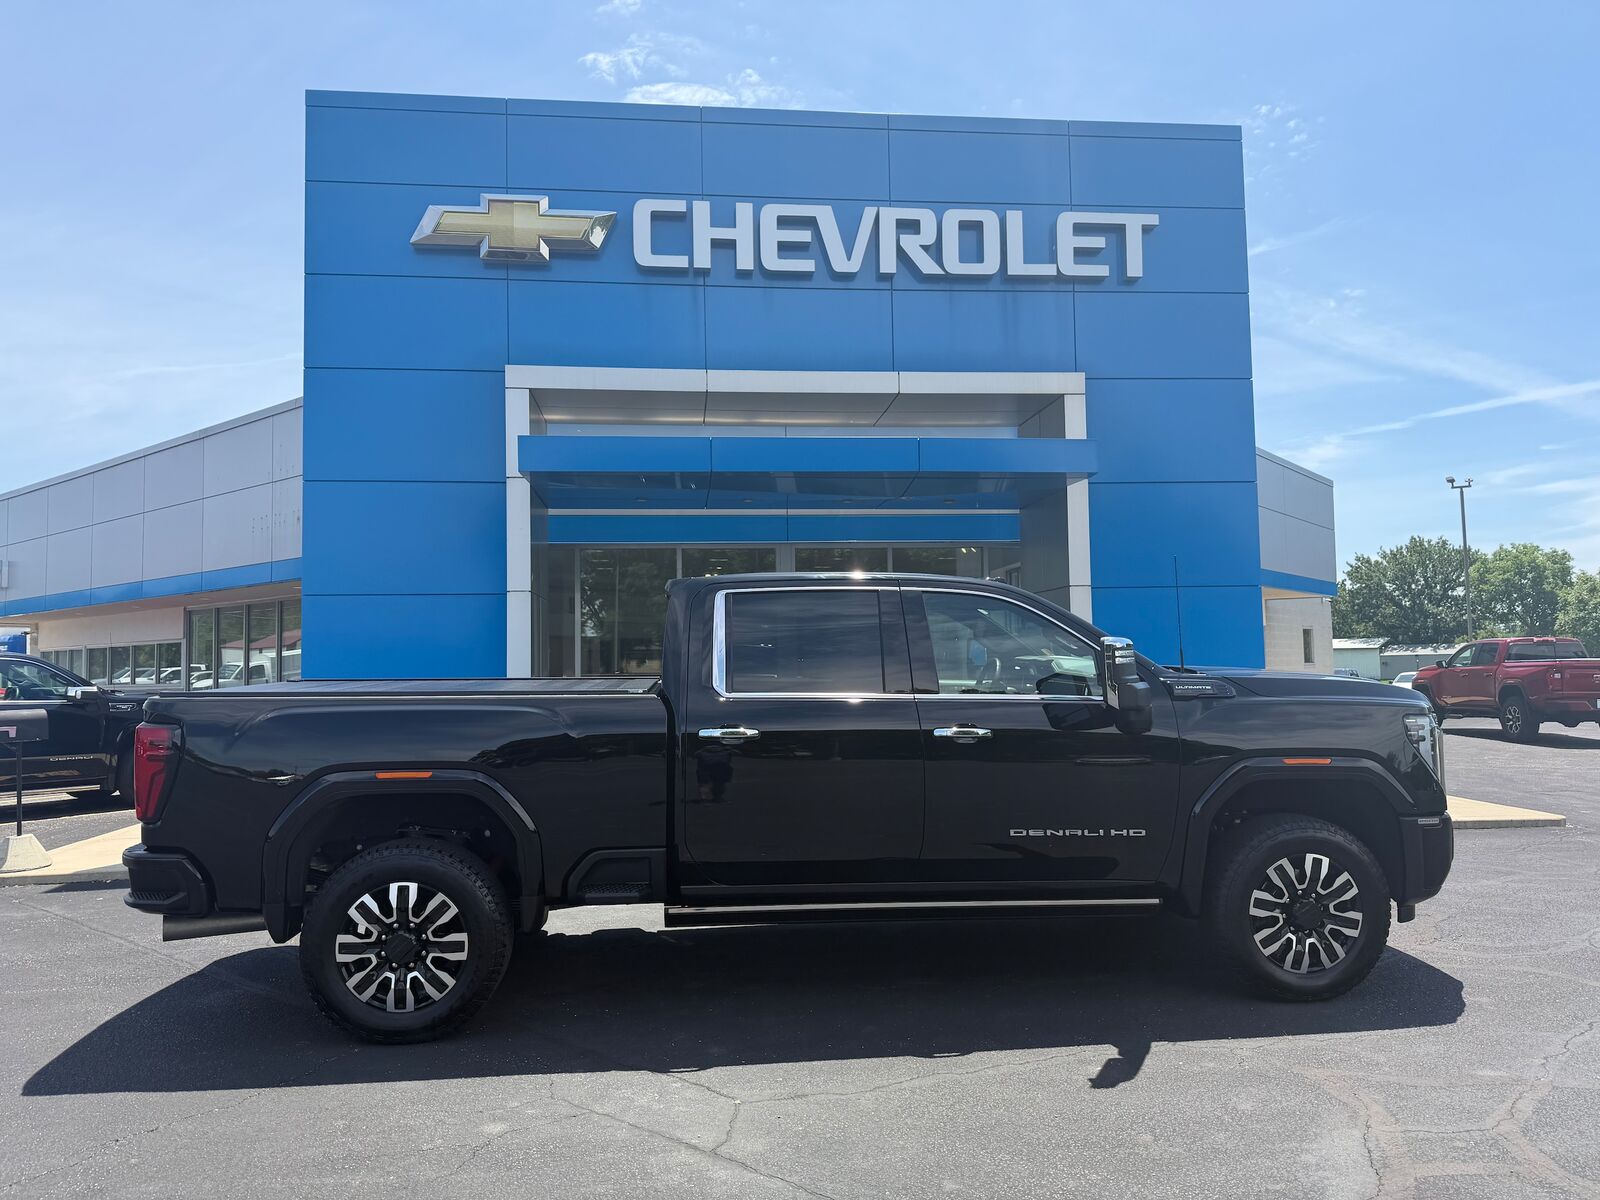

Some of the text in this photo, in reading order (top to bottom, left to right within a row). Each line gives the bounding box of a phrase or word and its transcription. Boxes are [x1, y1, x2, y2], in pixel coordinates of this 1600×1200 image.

[633, 198, 1159, 279] CHEVROLET
[1009, 828, 1147, 837] DENALI HD
